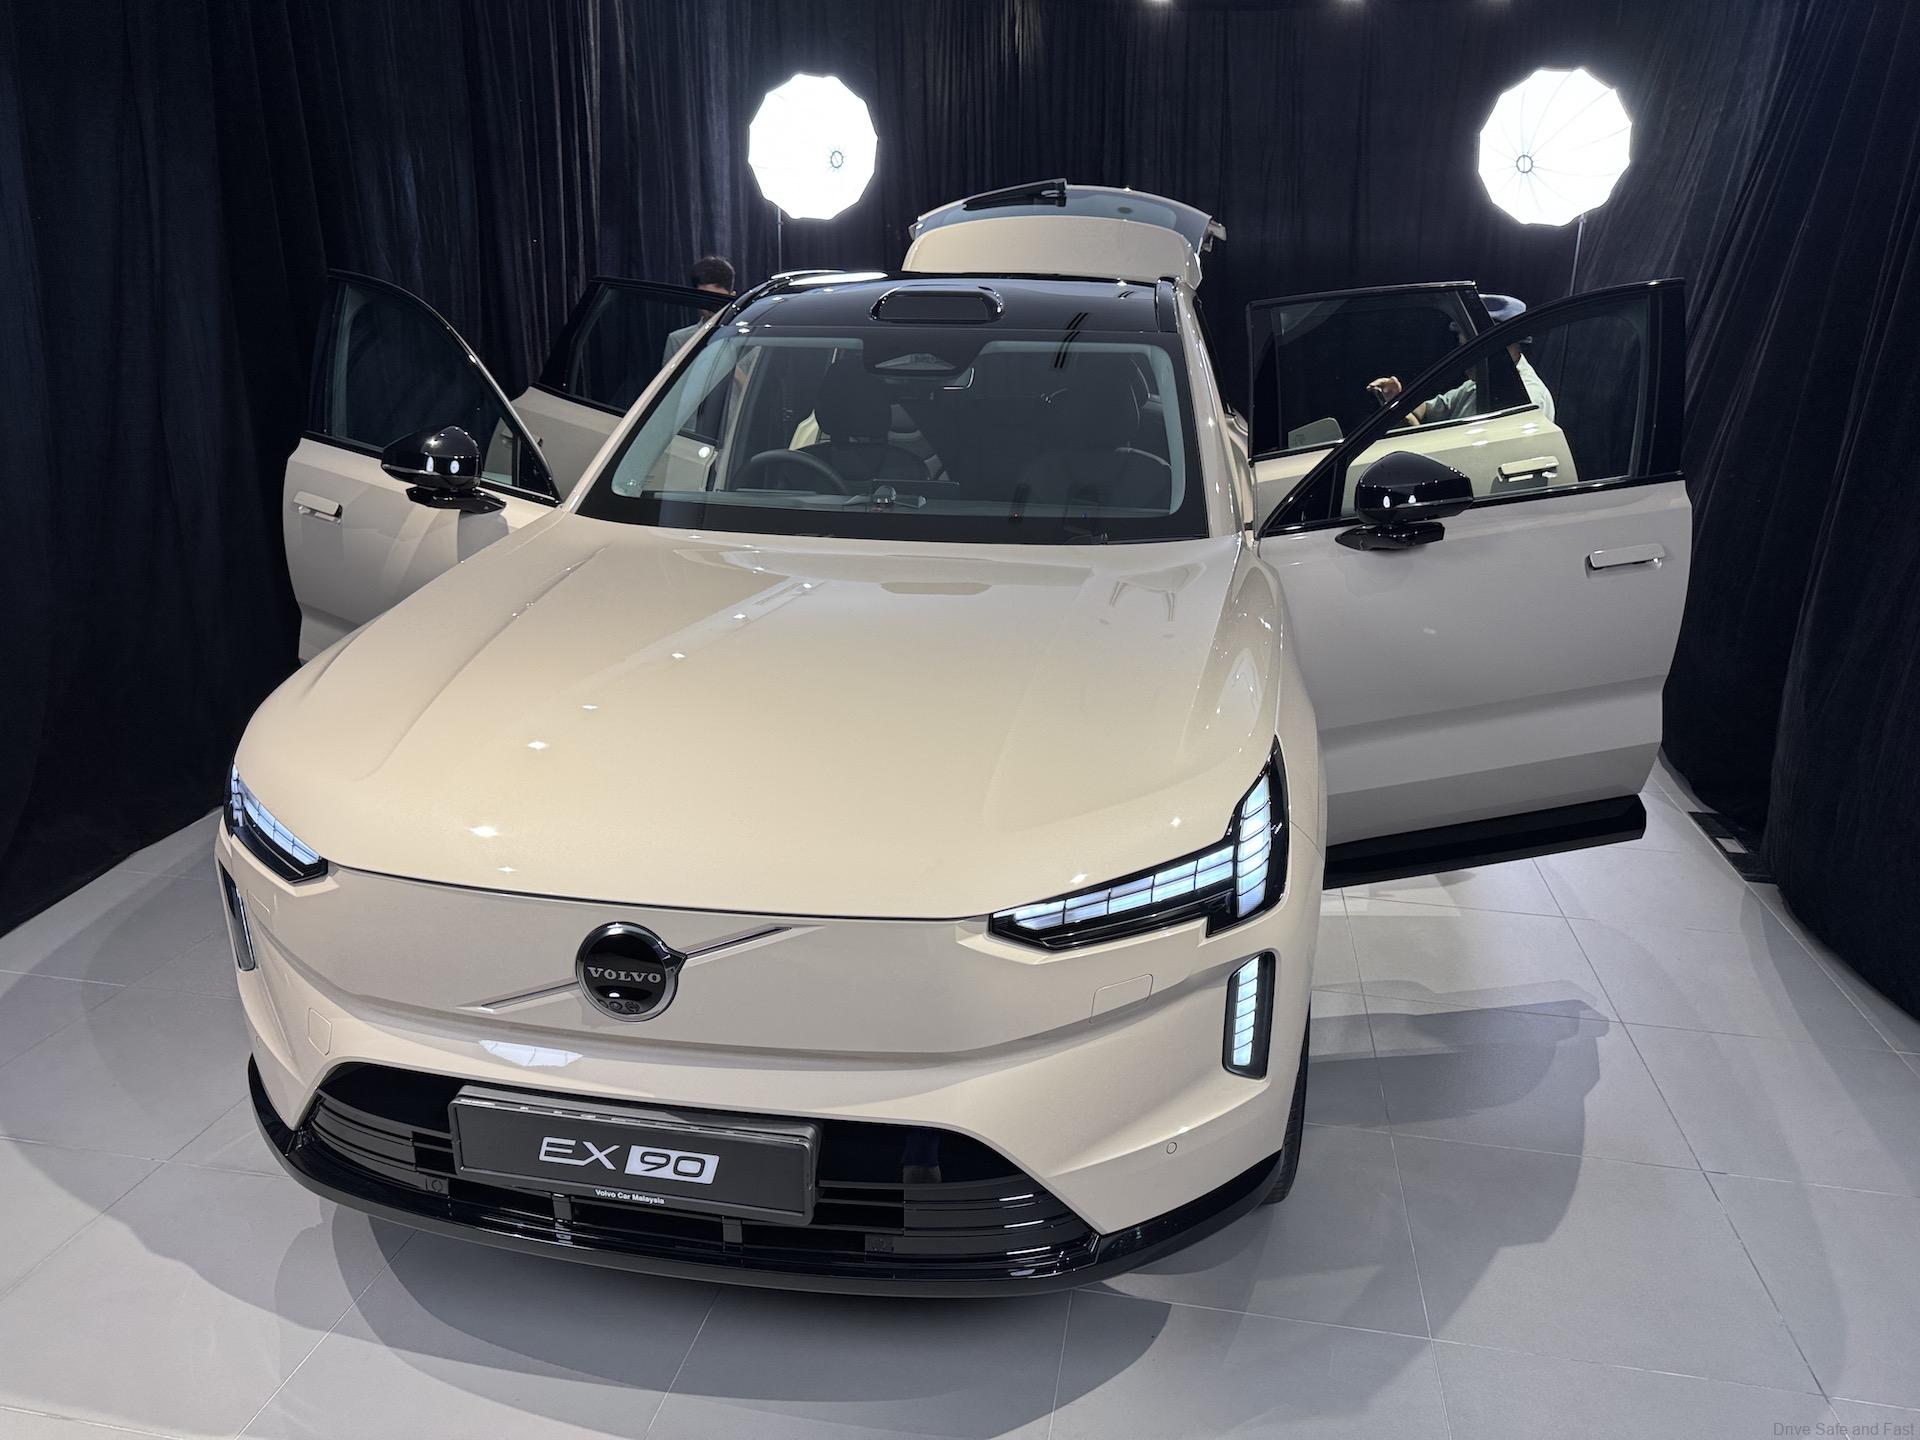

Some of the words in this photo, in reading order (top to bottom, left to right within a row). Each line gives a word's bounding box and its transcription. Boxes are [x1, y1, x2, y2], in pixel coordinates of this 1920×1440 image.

[587, 966, 661, 983] VOLVO
[539, 1136, 621, 1170] EX
[638, 1149, 707, 1179] 90
[595, 1188, 616, 1198] Volvo
[617, 1191, 631, 1200] Car
[632, 1193, 665, 1204] Malaysia
